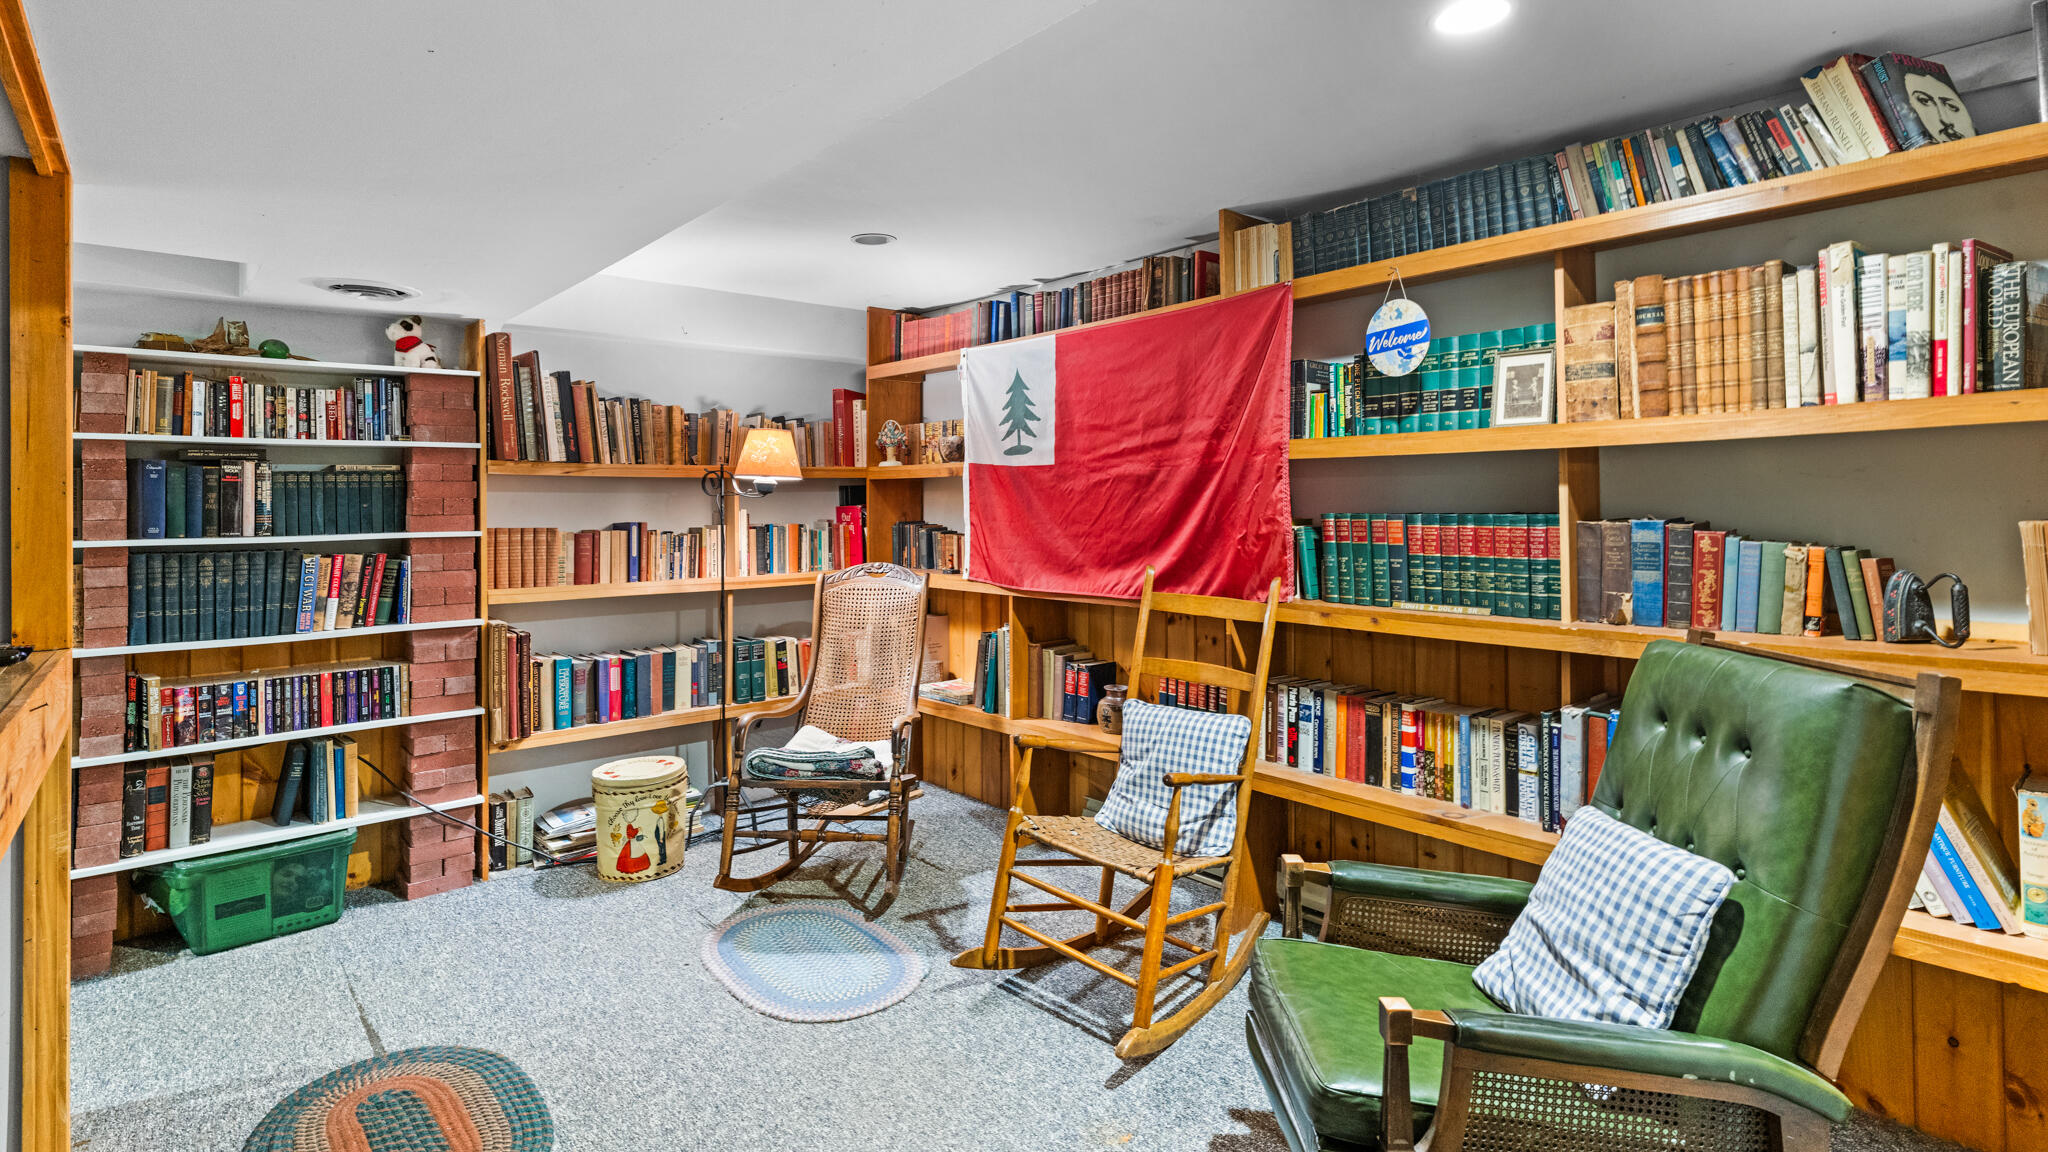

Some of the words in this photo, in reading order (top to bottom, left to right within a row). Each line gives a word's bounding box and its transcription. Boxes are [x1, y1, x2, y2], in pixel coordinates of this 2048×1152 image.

[1872, 58, 1889, 84] PROUST
[1891, 52, 1945, 74] PROUST
[1811, 81, 1833, 118] BERTRAND
[1831, 117, 1853, 151] RUSSELL
[1831, 75, 1854, 112] BERTRAND
[1851, 112, 1873, 146] RUSSELL
[2003, 267, 2020, 299] THE
[1987, 274, 2003, 328] WORLD
[497, 335, 508, 373] Norman
[1369, 326, 1428, 353] Welcome
[2002, 302, 2020, 381] EUROPEAN
[328, 404, 336, 421] RED
[499, 378, 513, 420] Rockwell
[333, 556, 341, 577] PRIMARY
[302, 588, 313, 611] WAR
[331, 578, 340, 597] COLORS
[1288, 687, 1298, 706] Mario
[1288, 706, 1298, 723] Puzo
[1519, 728, 1528, 768] CUSSLER
[1527, 735, 1536, 763] CLIVE
[173, 778, 182, 827] PHILADELPHIANS
[1519, 781, 1527, 808] FOUND
[1527, 777, 1536, 816] ATLANTIS
[518, 805, 532, 821] TOM
[518, 824, 532, 857] WOLFE
[1934, 832, 1951, 858] ANTIQUE
[1948, 857, 1970, 889] FURNITURE
